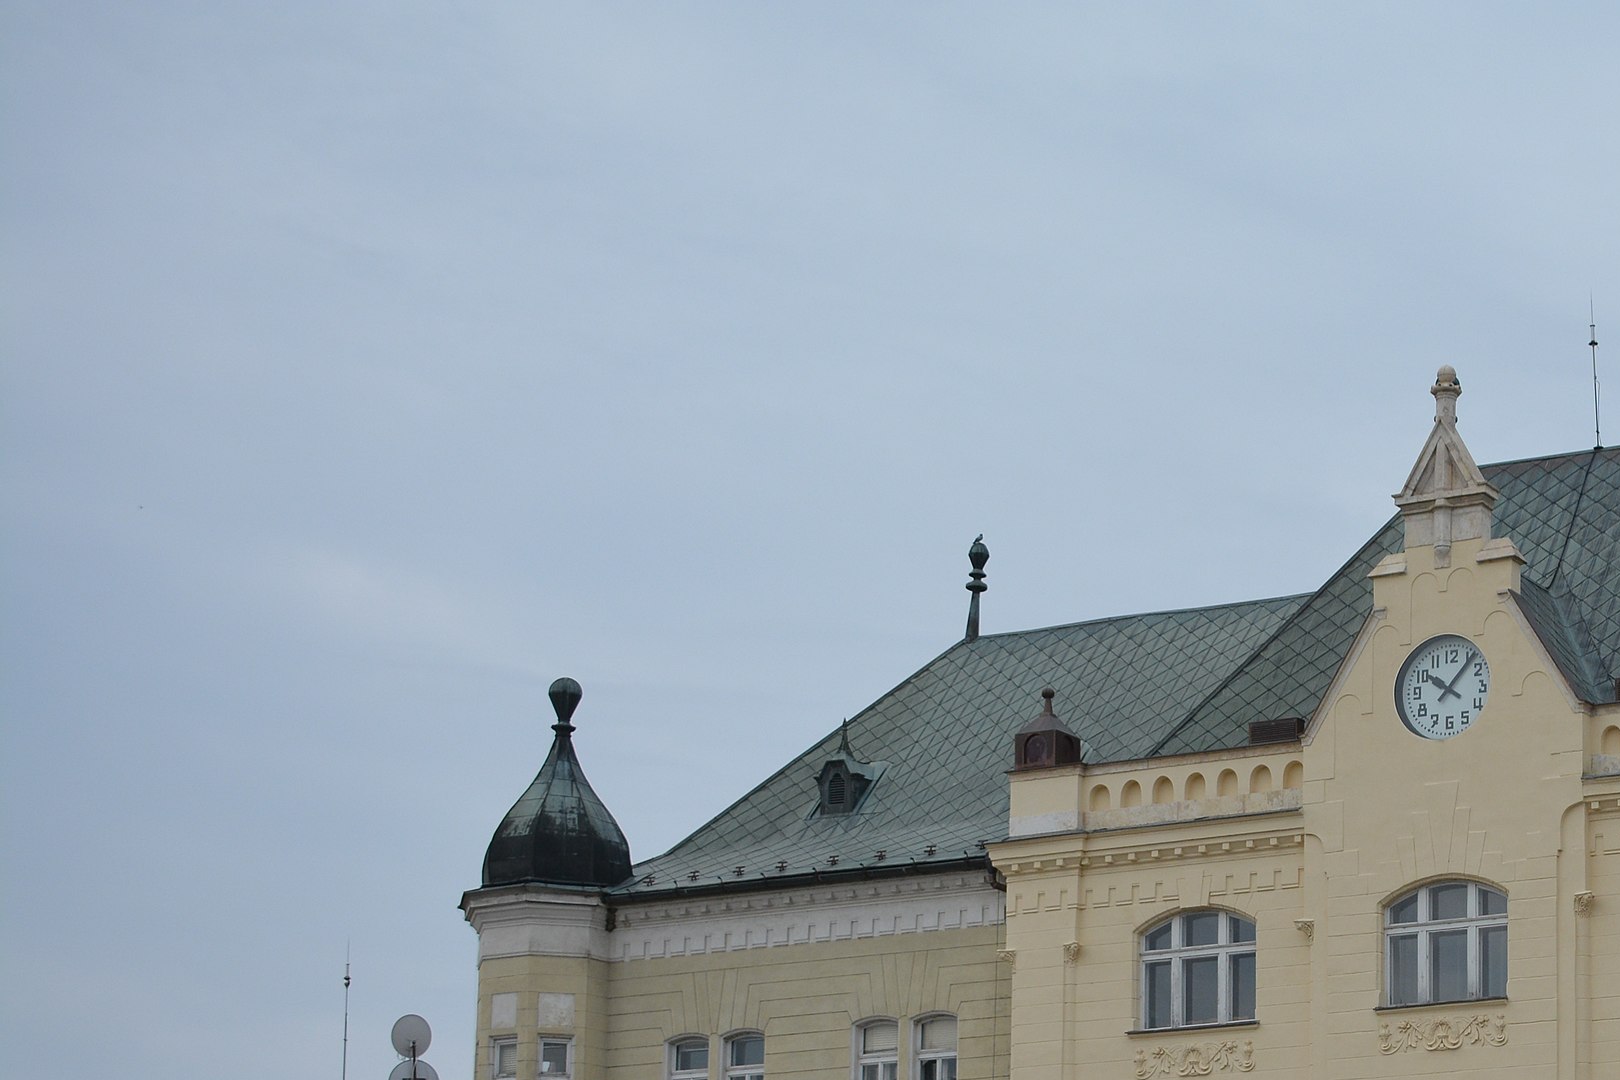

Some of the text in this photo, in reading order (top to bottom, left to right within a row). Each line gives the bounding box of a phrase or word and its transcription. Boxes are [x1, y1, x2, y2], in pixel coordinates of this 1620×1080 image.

[1431, 654, 1440, 669] 11
[1445, 649, 1459, 664] 12
[1417, 669, 1429, 684] 10
[1474, 662, 1482, 677] 2
[1413, 686, 1421, 700] 9
[1479, 679, 1487, 693] 3
[1418, 703, 1427, 717] 8
[1473, 697, 1483, 711] 4
[1430, 714, 1439, 728] 7
[1445, 716, 1454, 730] 6
[1461, 710, 1469, 725] 5
